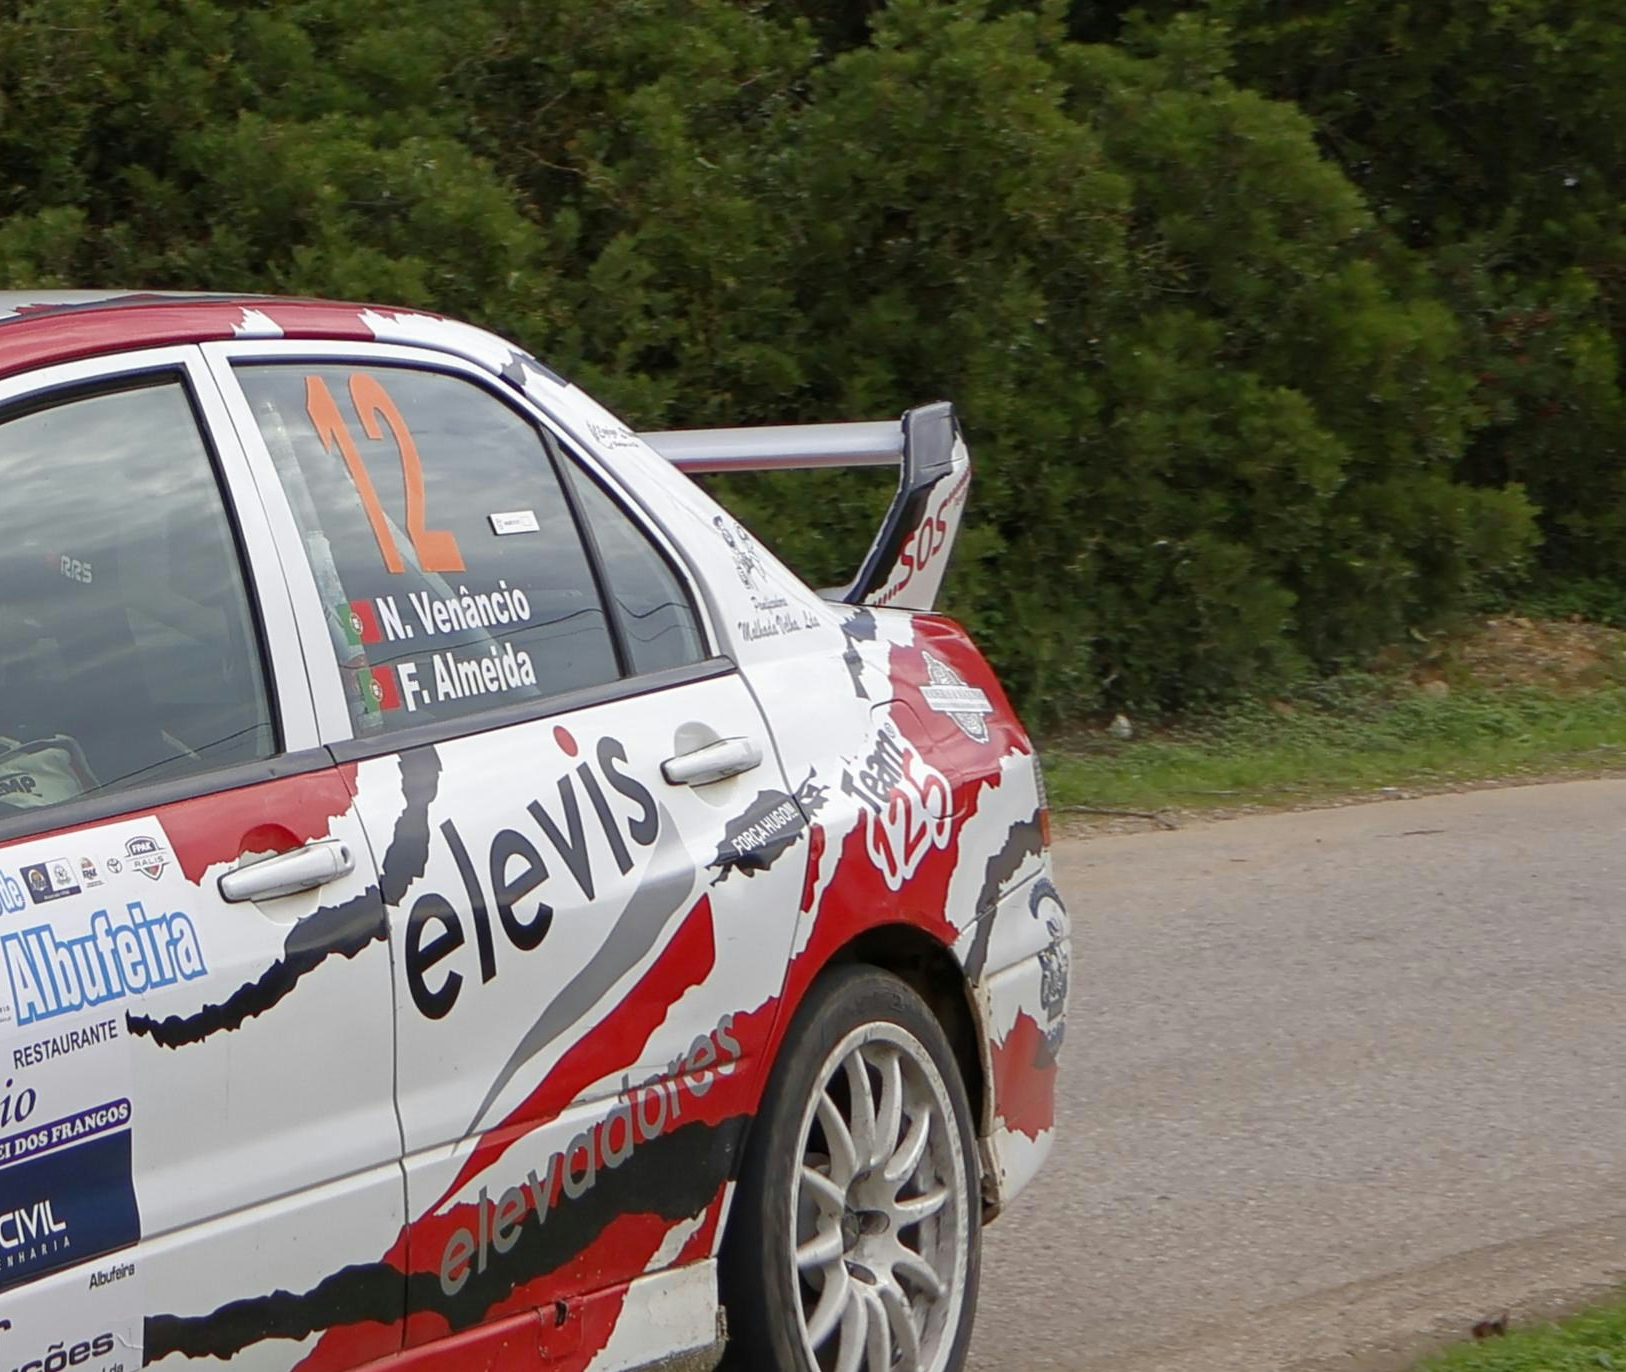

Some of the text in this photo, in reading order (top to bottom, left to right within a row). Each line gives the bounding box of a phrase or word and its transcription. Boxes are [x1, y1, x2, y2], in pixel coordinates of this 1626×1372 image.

[306, 373, 466, 574] 12
[60, 554, 93, 584] RRS
[898, 500, 947, 591] SOS
[376, 579, 532, 642] N. Venâncio
[397, 644, 537, 712] F. Almeida
[131, 840, 154, 855] FPAK
[133, 855, 165, 868] RALIS
[730, 823, 771, 857] FORÇA
[404, 725, 660, 1021] elevis
[1, 901, 208, 1026] Albufeira
[13, 1018, 118, 1069] RESTAURANTE
[14, 1130, 49, 1158] DOS
[50, 1103, 129, 1145] FRANGOS
[438, 1012, 743, 1296] elevadores
[88, 1262, 136, 1291] Albufeira
